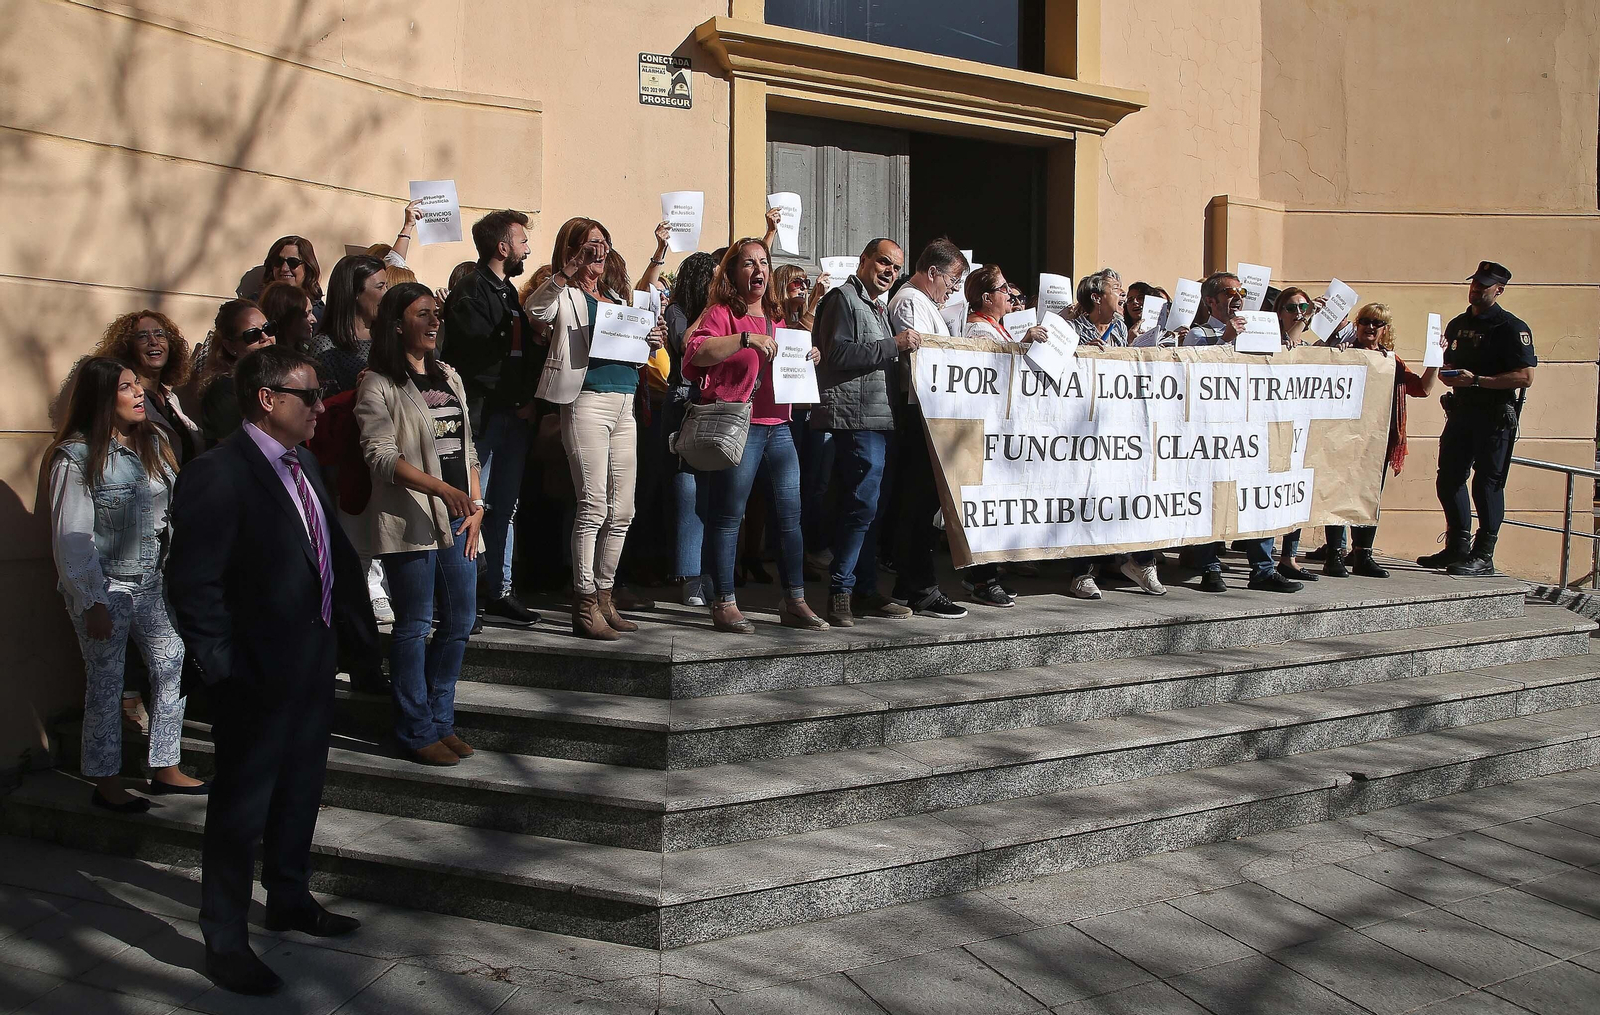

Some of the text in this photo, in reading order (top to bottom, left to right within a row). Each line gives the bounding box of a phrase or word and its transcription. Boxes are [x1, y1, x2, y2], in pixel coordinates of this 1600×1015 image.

[641, 54, 690, 67] CONECTADA
[642, 95, 690, 107] PROSEGUR
[945, 364, 1000, 395] POR
[1020, 369, 1084, 398] UNA
[1097, 373, 1184, 401] L.O.E.O.
[1199, 376, 1241, 401] SIN
[1250, 376, 1353, 401] TRAMPAS!
[984, 428, 1303, 462] FUNCIONES CLARAS Y
[963, 481, 1306, 528] RETRIBUCIONES JUSTAS
